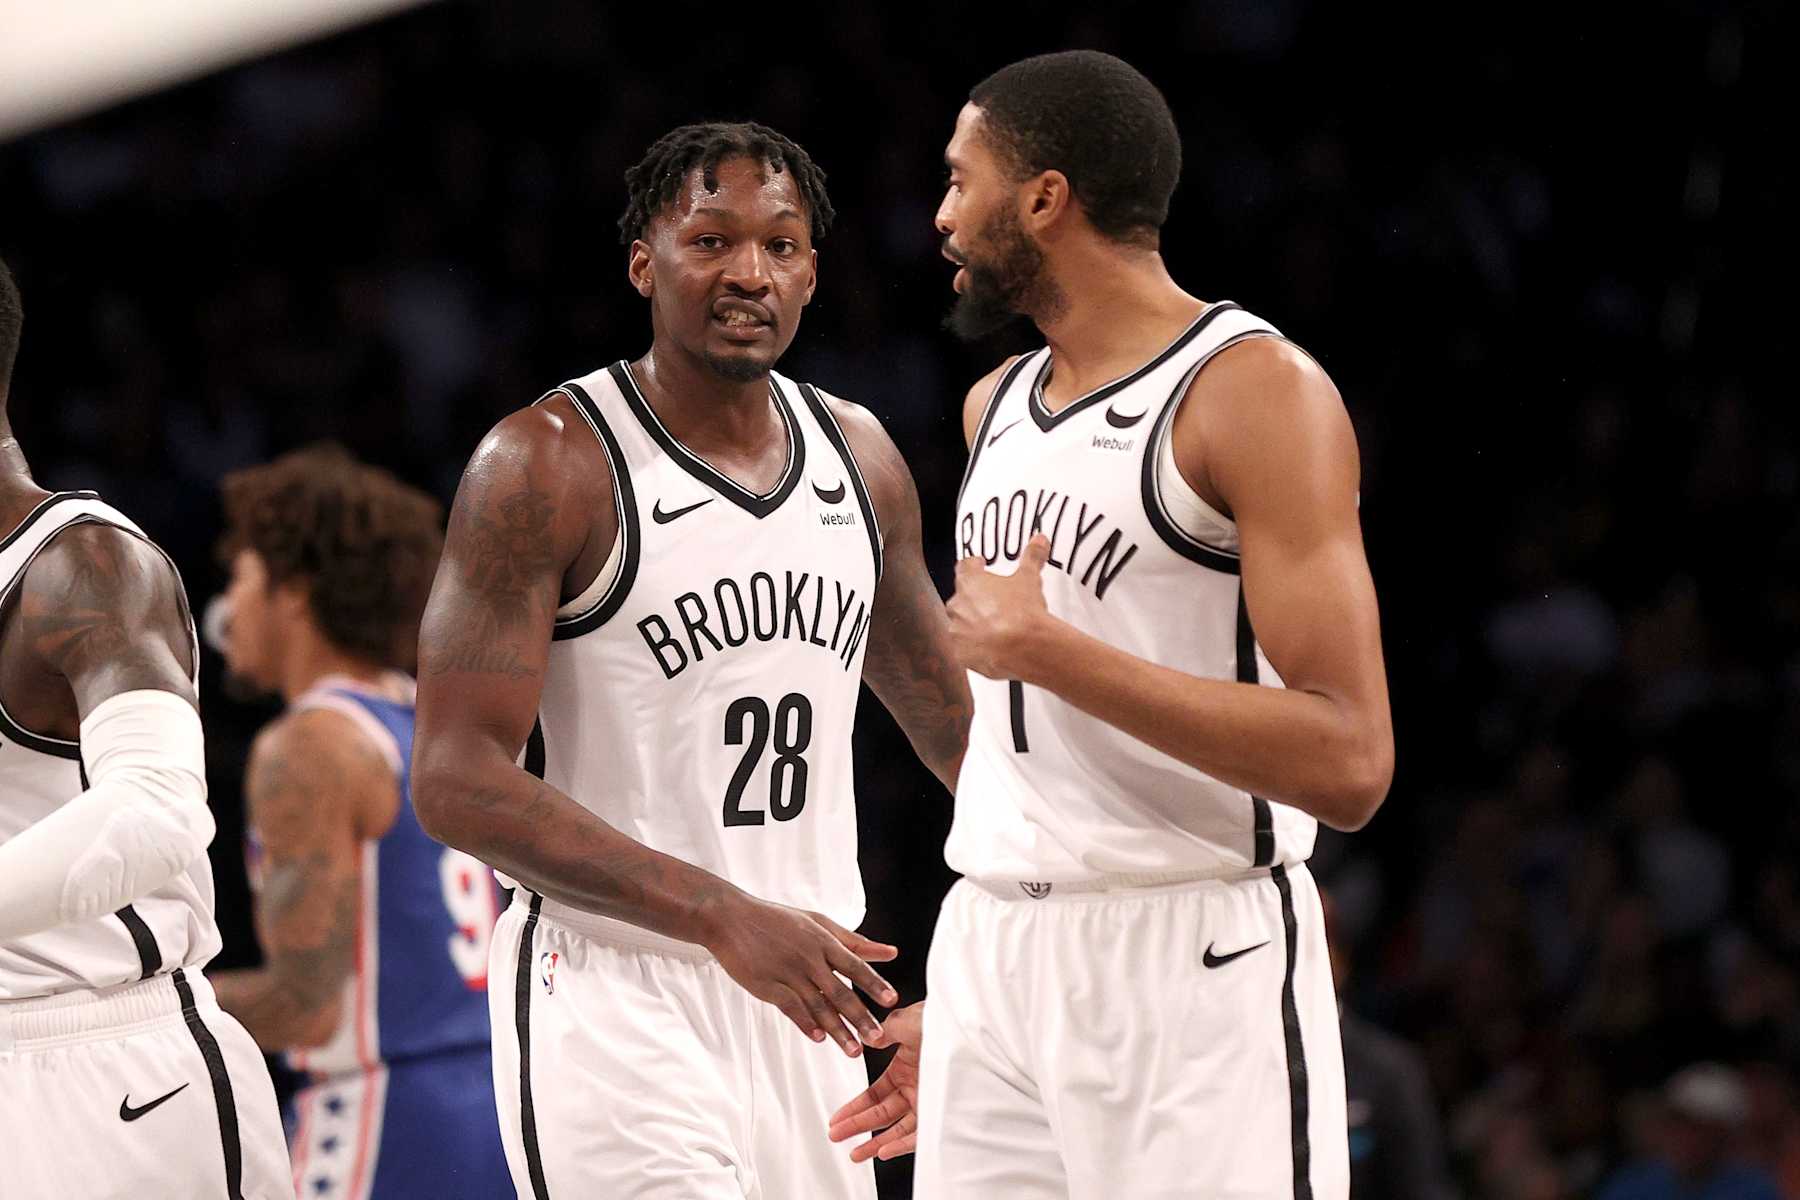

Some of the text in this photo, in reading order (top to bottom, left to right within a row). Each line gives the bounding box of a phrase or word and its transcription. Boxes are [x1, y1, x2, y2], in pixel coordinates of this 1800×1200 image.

[1092, 435, 1134, 451] Webull
[819, 512, 855, 525] Webull
[961, 489, 1138, 601] ROOKLYN
[636, 571, 871, 680] BROOKLYN
[722, 692, 812, 827] 28
